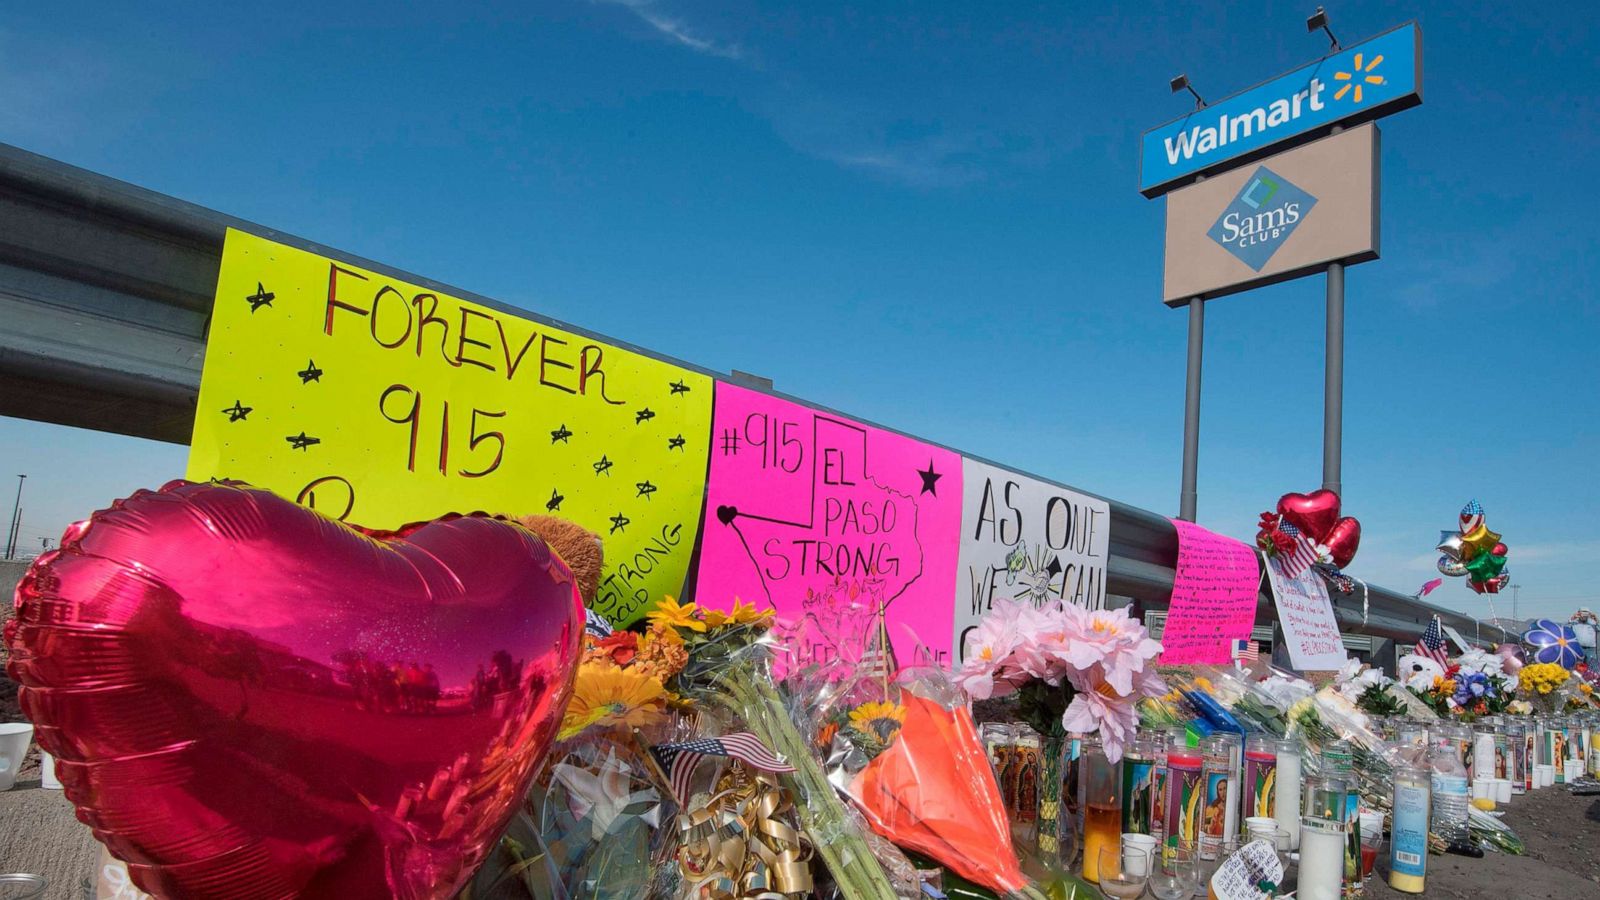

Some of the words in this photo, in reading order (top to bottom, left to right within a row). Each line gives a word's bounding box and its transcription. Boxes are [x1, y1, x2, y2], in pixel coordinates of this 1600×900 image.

[1163, 78, 1325, 165] Walmart
[1222, 202, 1300, 243] Sam's
[324, 262, 626, 405] FOREVER
[379, 383, 506, 478] 915
[719, 413, 803, 473] #915
[824, 448, 856, 486] EL
[825, 497, 896, 537] PASO
[975, 477, 1023, 546] AS
[1045, 496, 1106, 558] ONE
[595, 523, 683, 613] STRONG
[765, 538, 900, 580] STRONG
[969, 564, 1009, 615] WE
[1060, 563, 1102, 613] CAN
